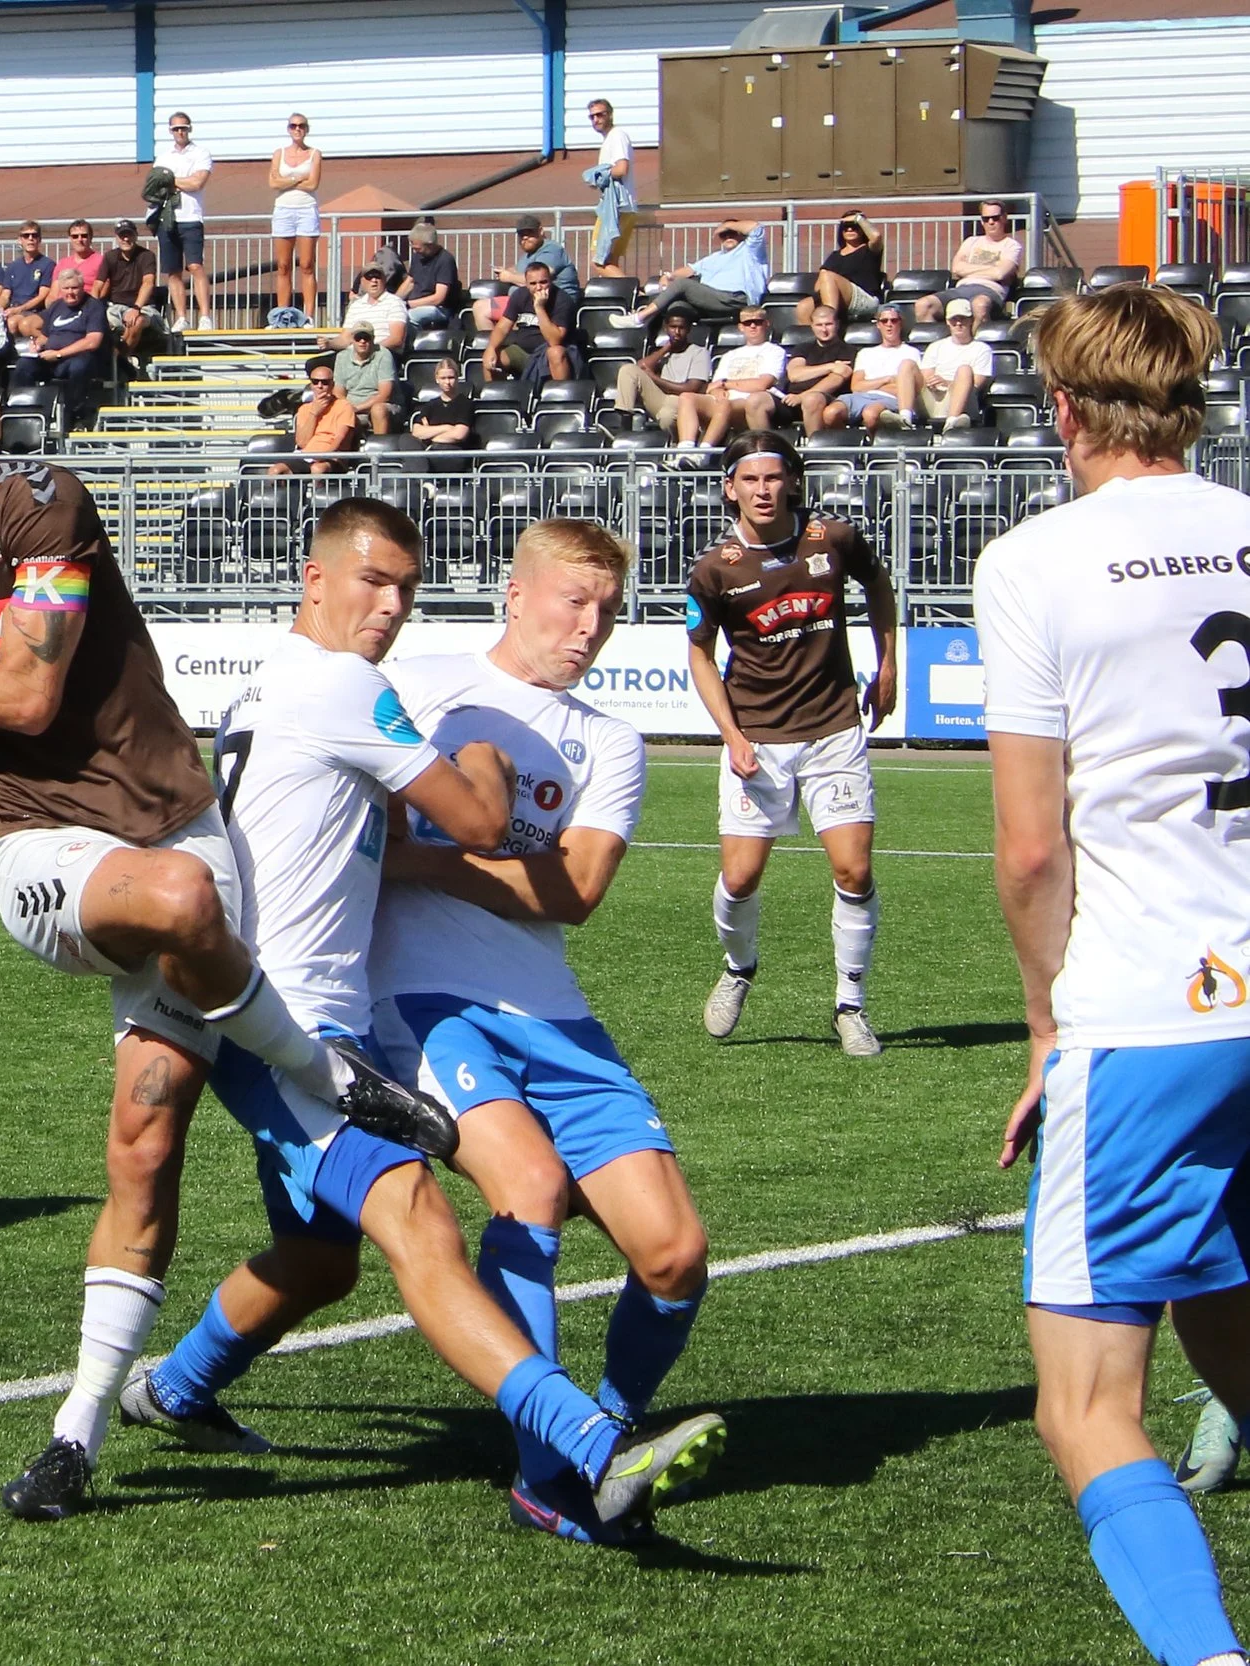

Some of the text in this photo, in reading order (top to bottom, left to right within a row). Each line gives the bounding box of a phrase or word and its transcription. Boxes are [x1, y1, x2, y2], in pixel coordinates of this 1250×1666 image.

[1107, 555, 1233, 583] SOLBERG
[22, 566, 65, 604] K
[757, 598, 824, 627] MENY
[567, 667, 688, 691] OTRON
[594, 699, 688, 709] Performance for Life
[935, 714, 974, 726] Horten,
[830, 782, 853, 800] 24
[740, 796, 751, 812] B
[827, 801, 860, 814] hummel
[154, 997, 206, 1031] hummel
[456, 1062, 476, 1092] 6
